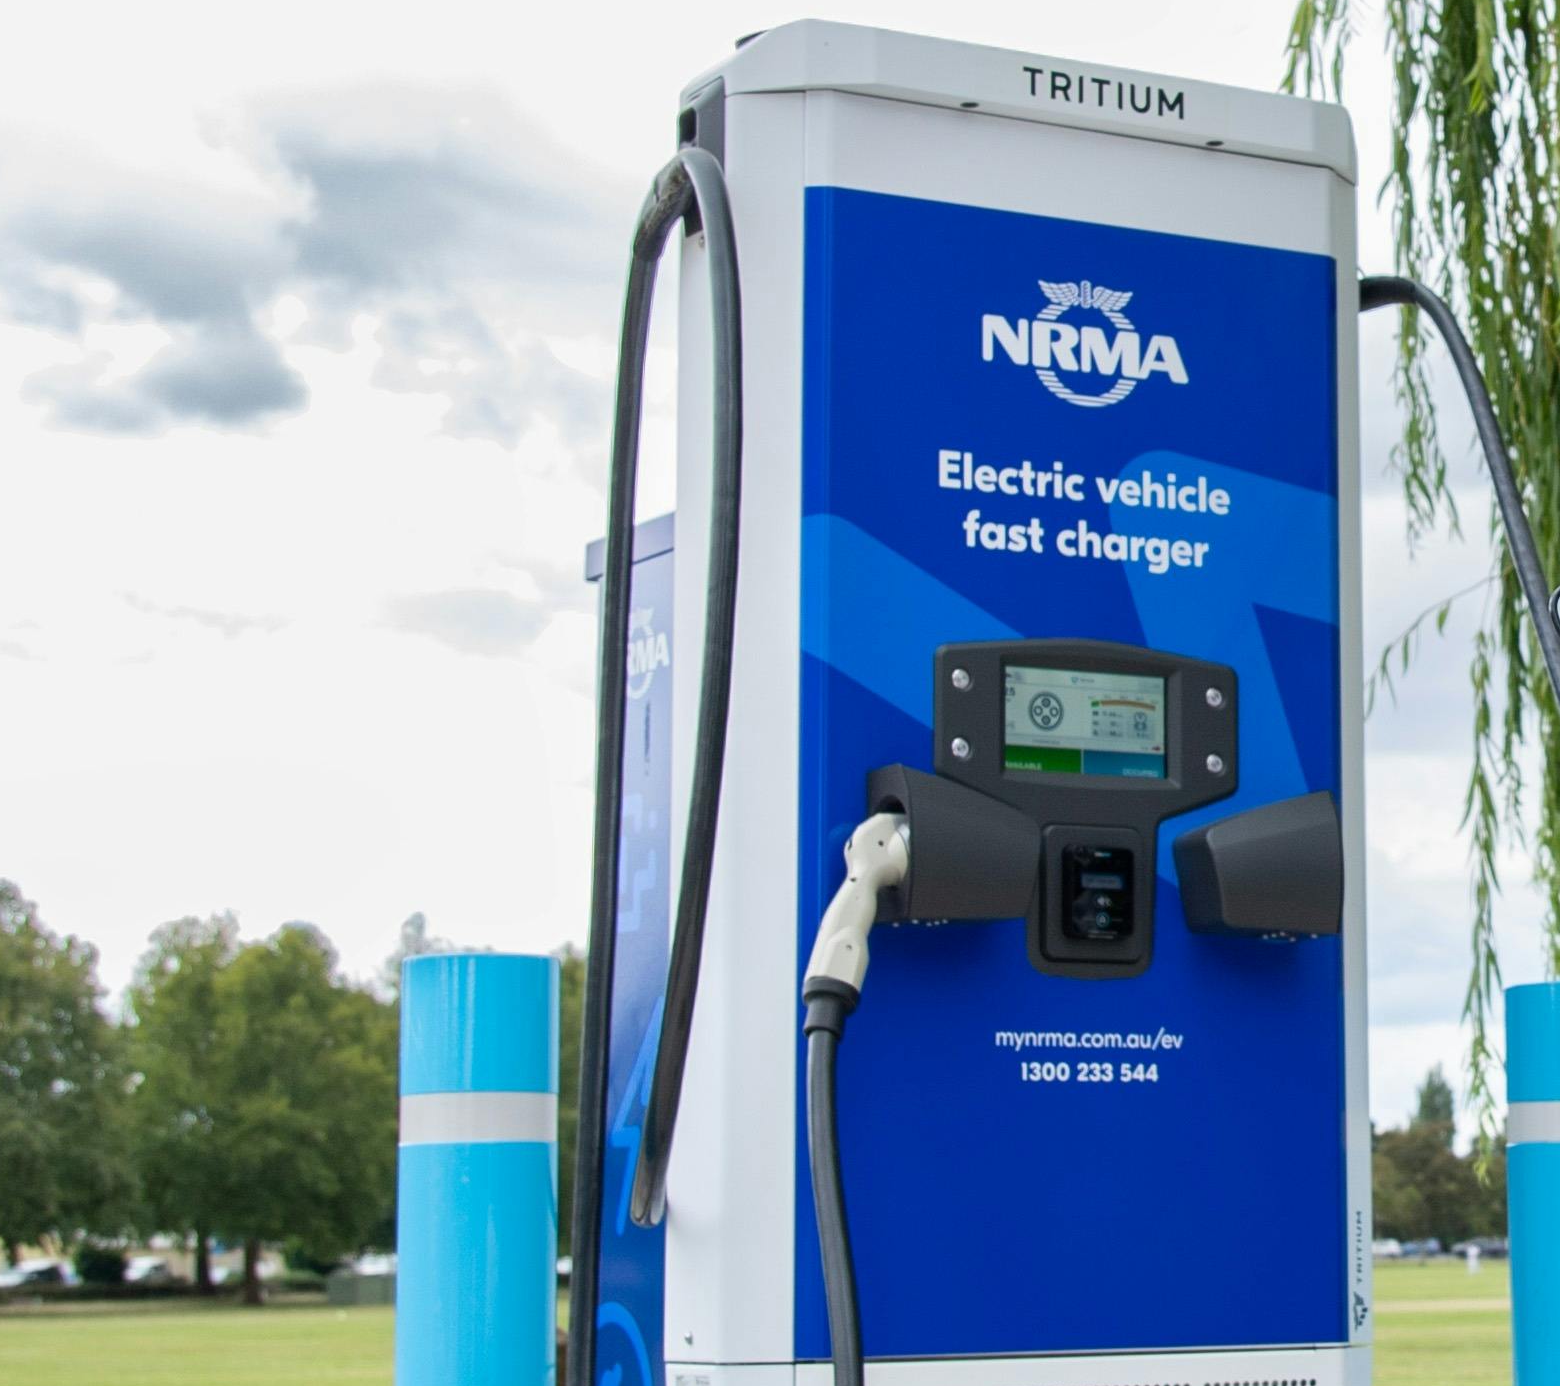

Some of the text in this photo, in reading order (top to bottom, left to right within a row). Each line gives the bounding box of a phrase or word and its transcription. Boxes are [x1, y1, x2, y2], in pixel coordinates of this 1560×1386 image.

[1022, 66, 1186, 120] TRITIUM
[981, 314, 1190, 386] NRMA
[938, 449, 1231, 515] Electric vehicle
[962, 509, 1210, 574] fast charger
[626, 631, 671, 671] RMA
[994, 1027, 1184, 1052] mynrma.com.au/ev
[1020, 1062, 1159, 1083] 1300 233 544
